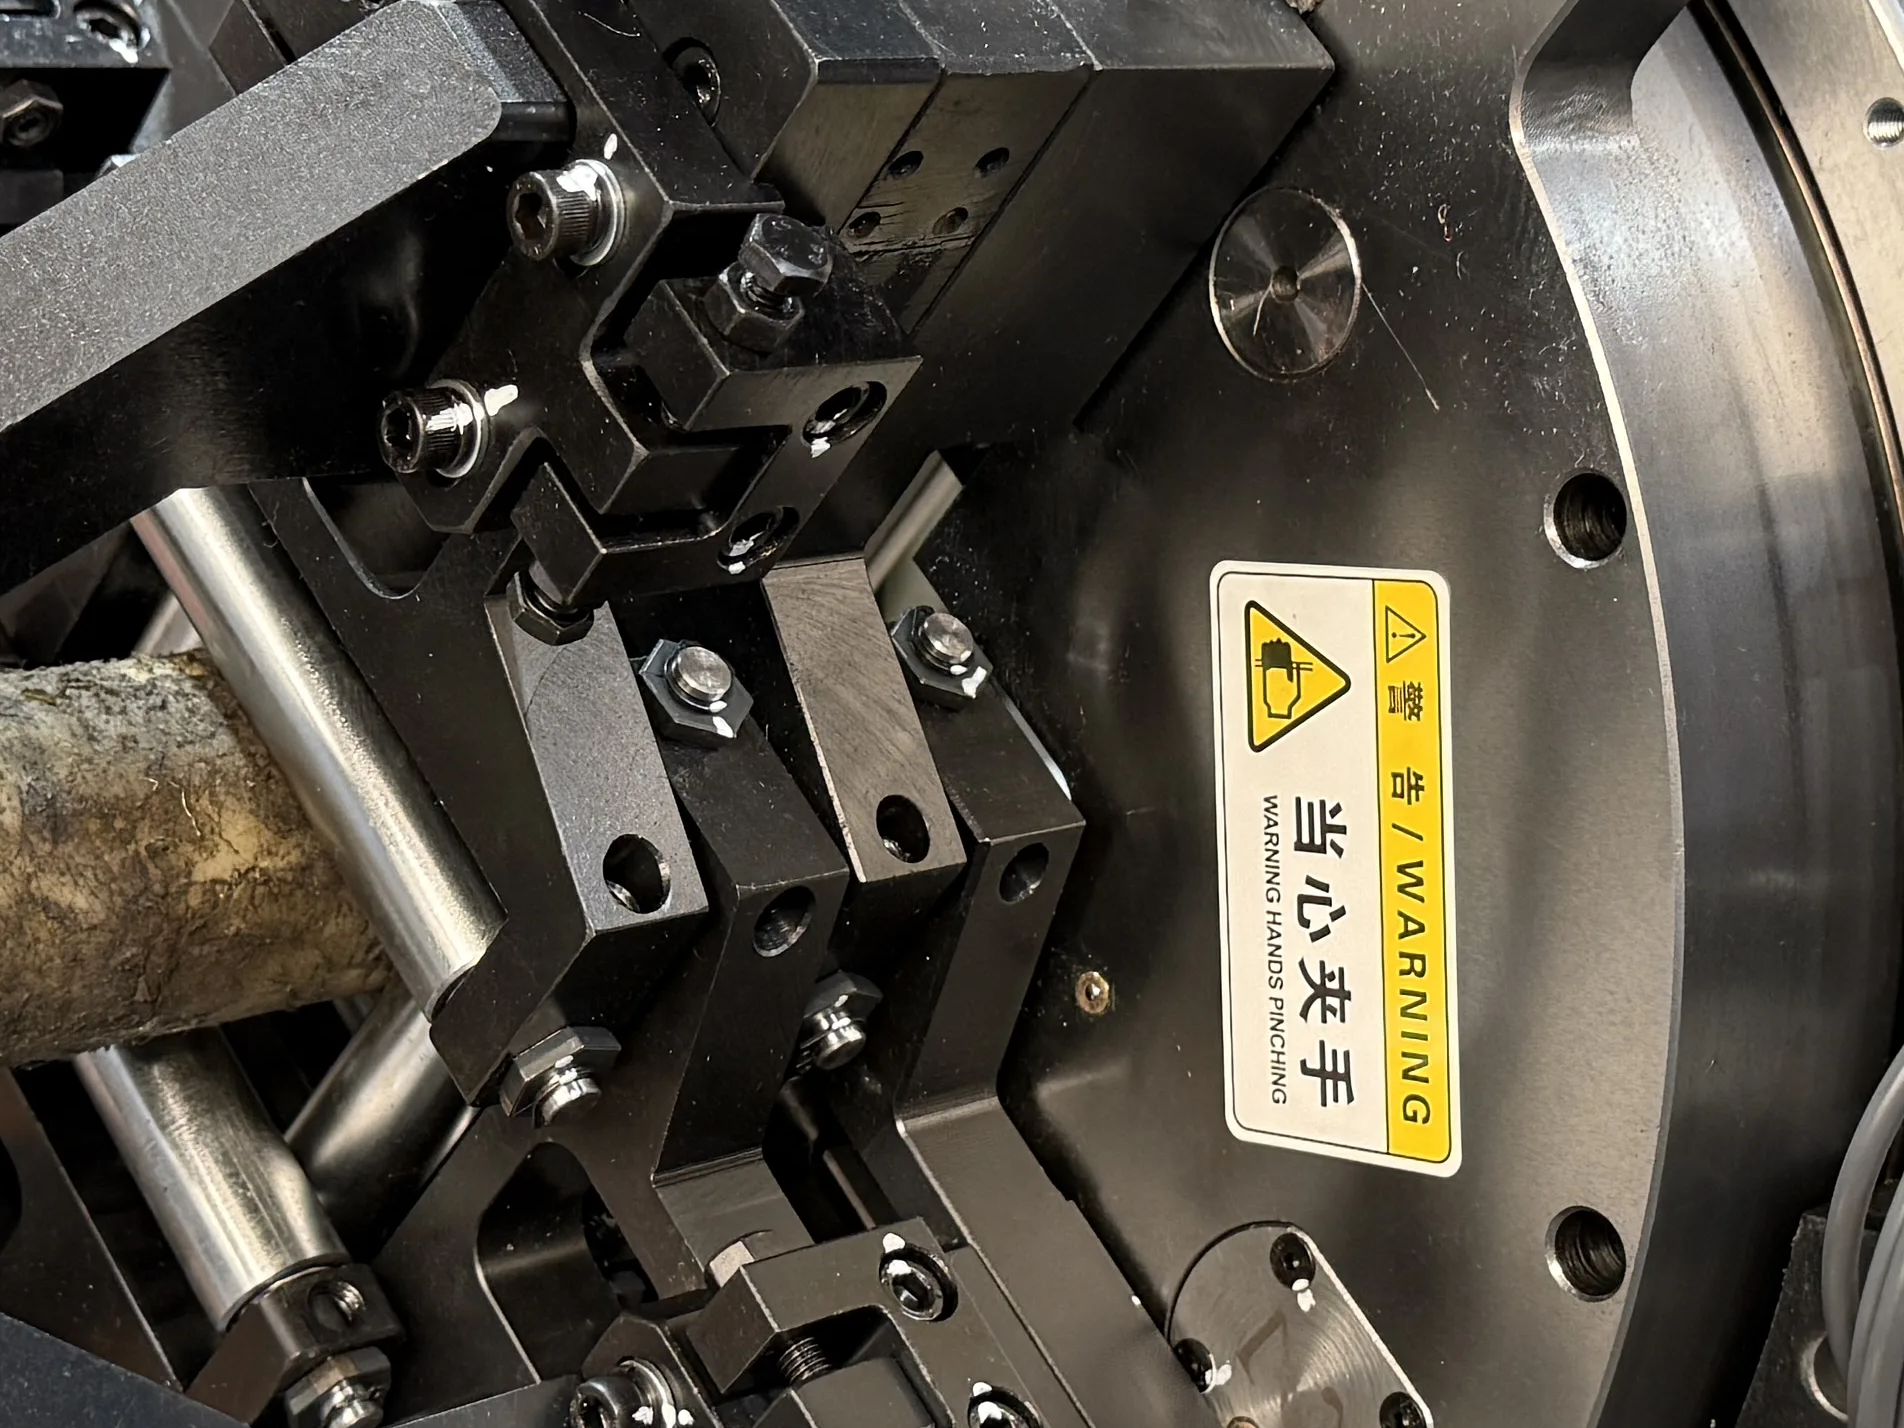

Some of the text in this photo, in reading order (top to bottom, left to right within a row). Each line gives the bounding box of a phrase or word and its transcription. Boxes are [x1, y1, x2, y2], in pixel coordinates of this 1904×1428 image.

[1263, 795, 1286, 1105] WARNING HANDS PINCHING
[1294, 796, 1354, 1107] 当心夹手
